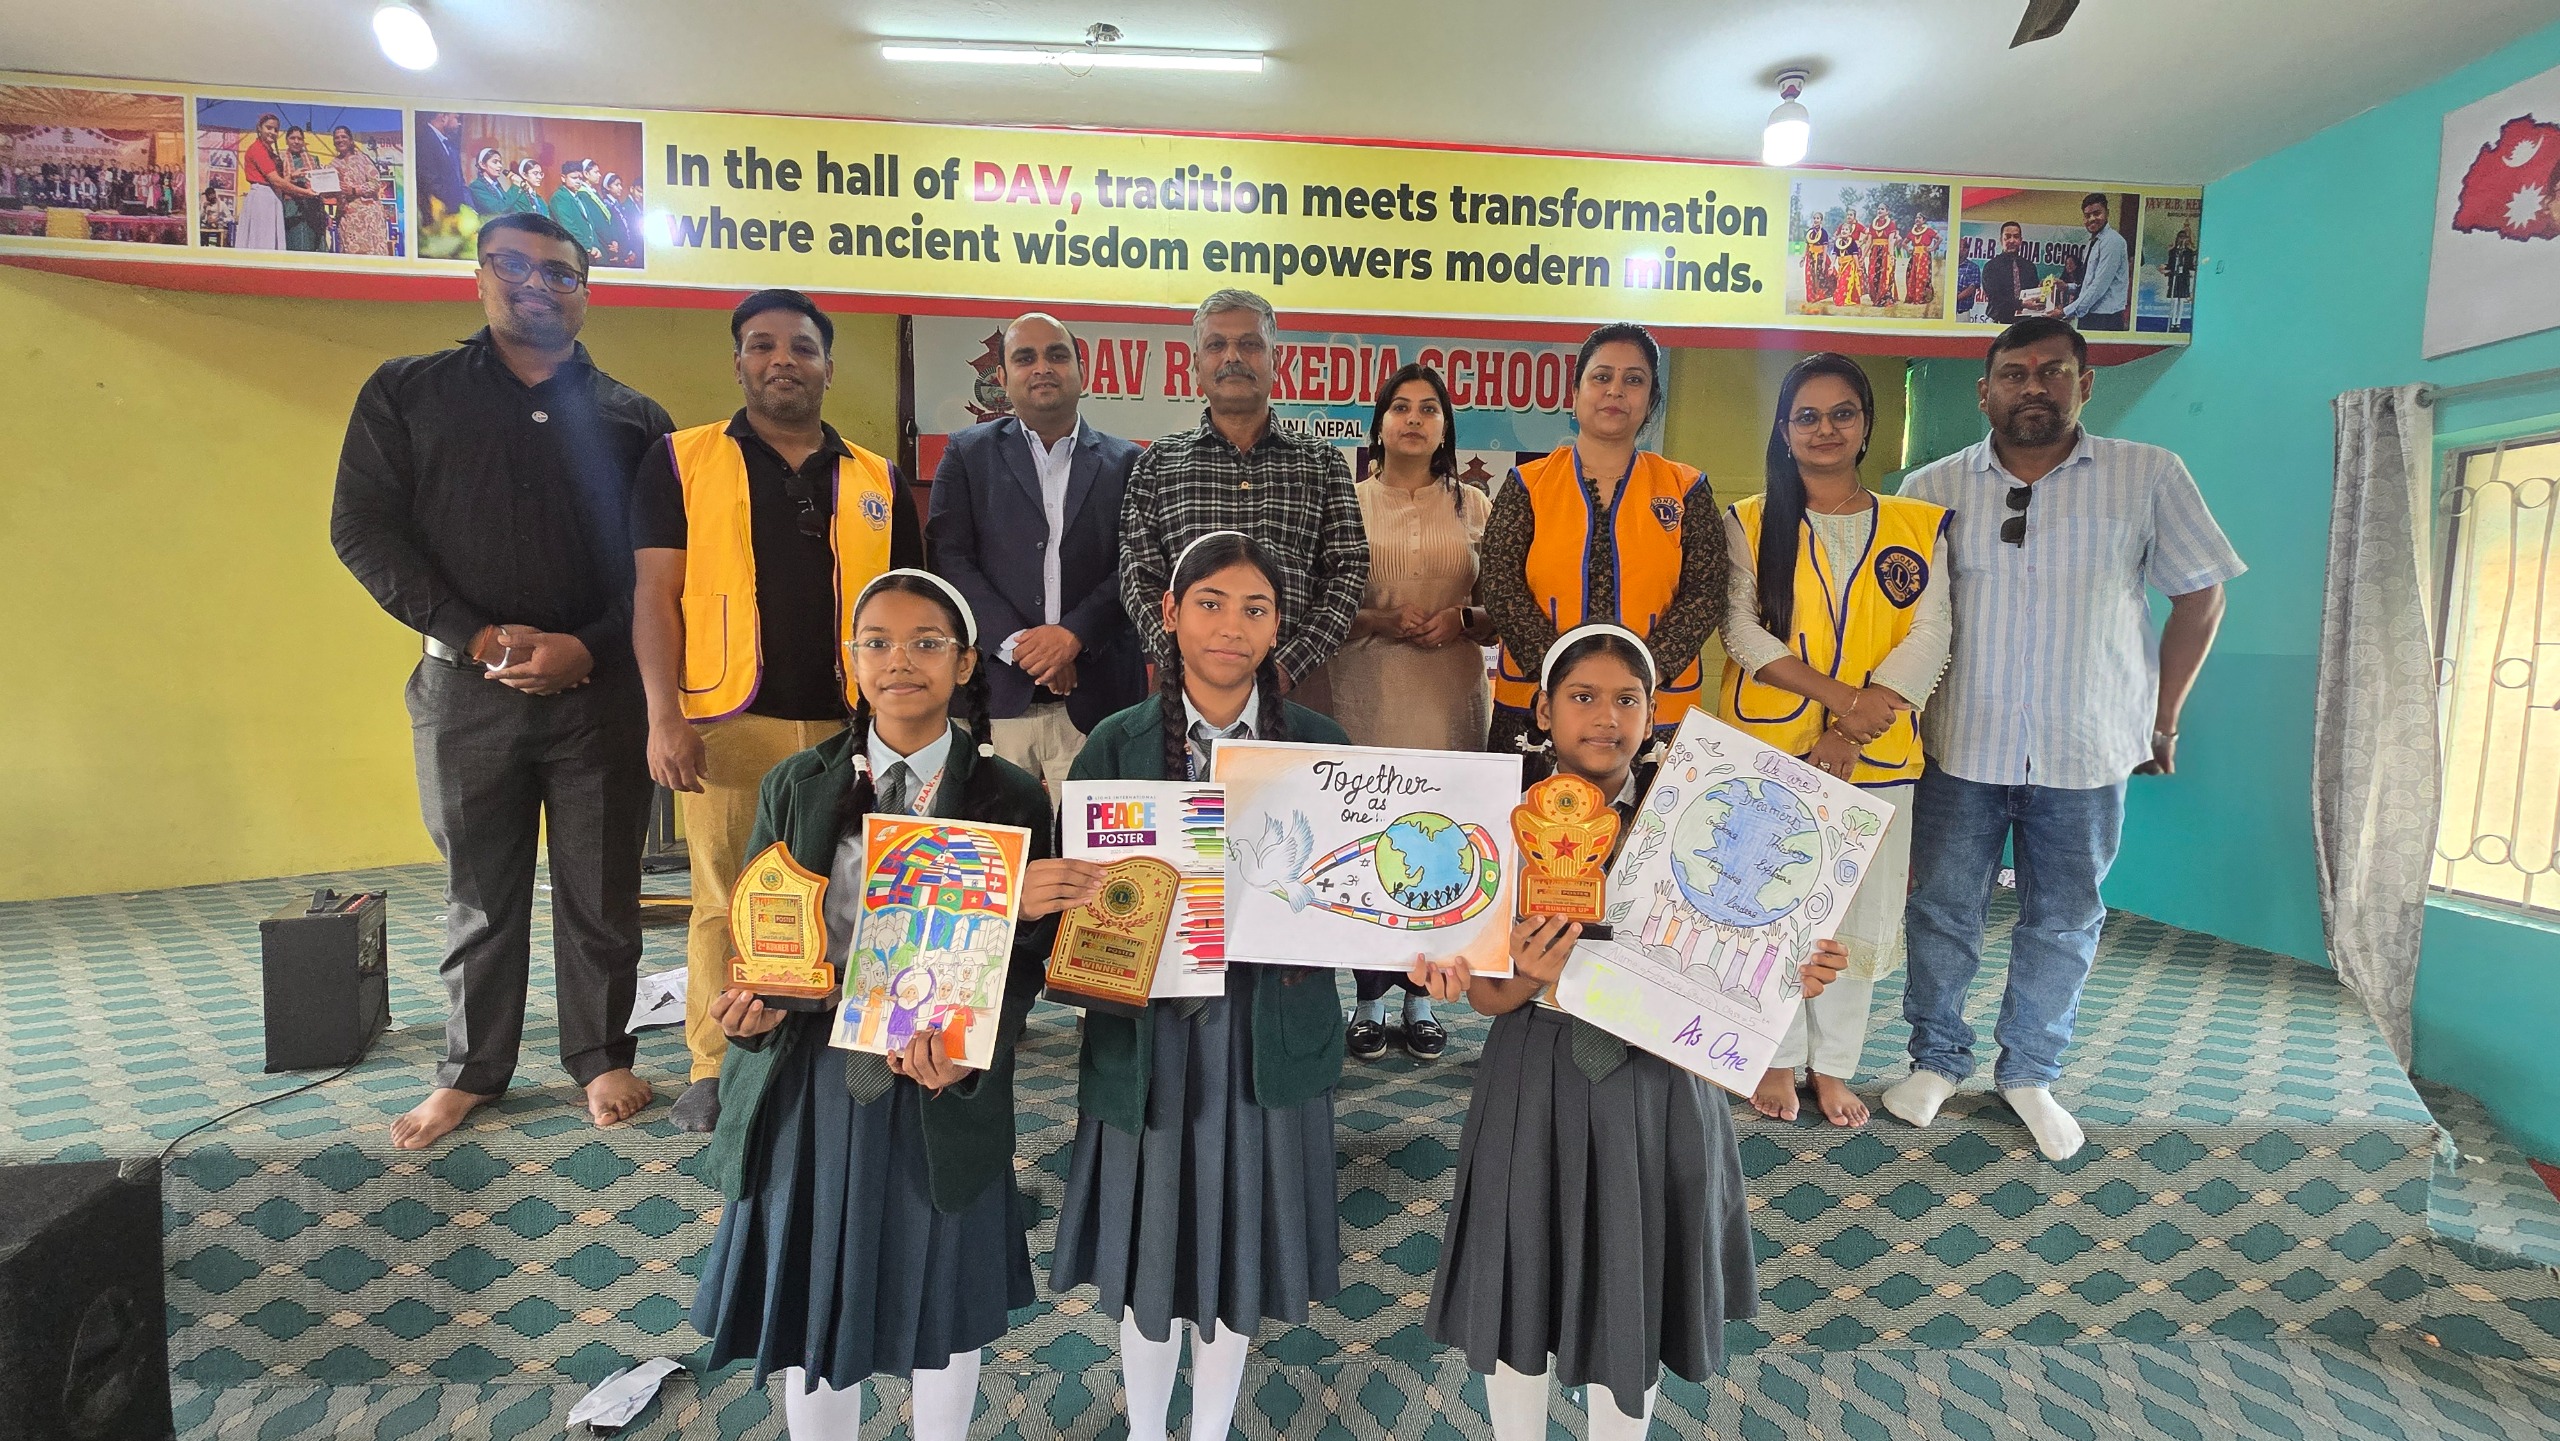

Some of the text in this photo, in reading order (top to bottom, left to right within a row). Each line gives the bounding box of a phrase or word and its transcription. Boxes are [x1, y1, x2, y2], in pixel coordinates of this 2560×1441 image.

[666, 144, 1768, 236] In the hall of DAV, tradition meets transformation
[668, 205, 1763, 294] where ancient wisdom empowers modern minds.
[1271, 344, 1398, 402] KEDIA
[1315, 420, 1363, 438] NEPAL
[1657, 507, 1670, 520] L
[1892, 554, 1918, 573] LIONS
[1313, 761, 1442, 805] Together
[1787, 774, 1811, 790] are
[1368, 797, 1387, 811] as
[1087, 802, 1156, 830] PEACE
[1099, 833, 1144, 844] POSTER
[791, 943, 799, 952] UP
[1107, 948, 1134, 957] POSTER
[1081, 961, 1125, 976] WINNER
[1672, 1014, 1749, 1072] As One
